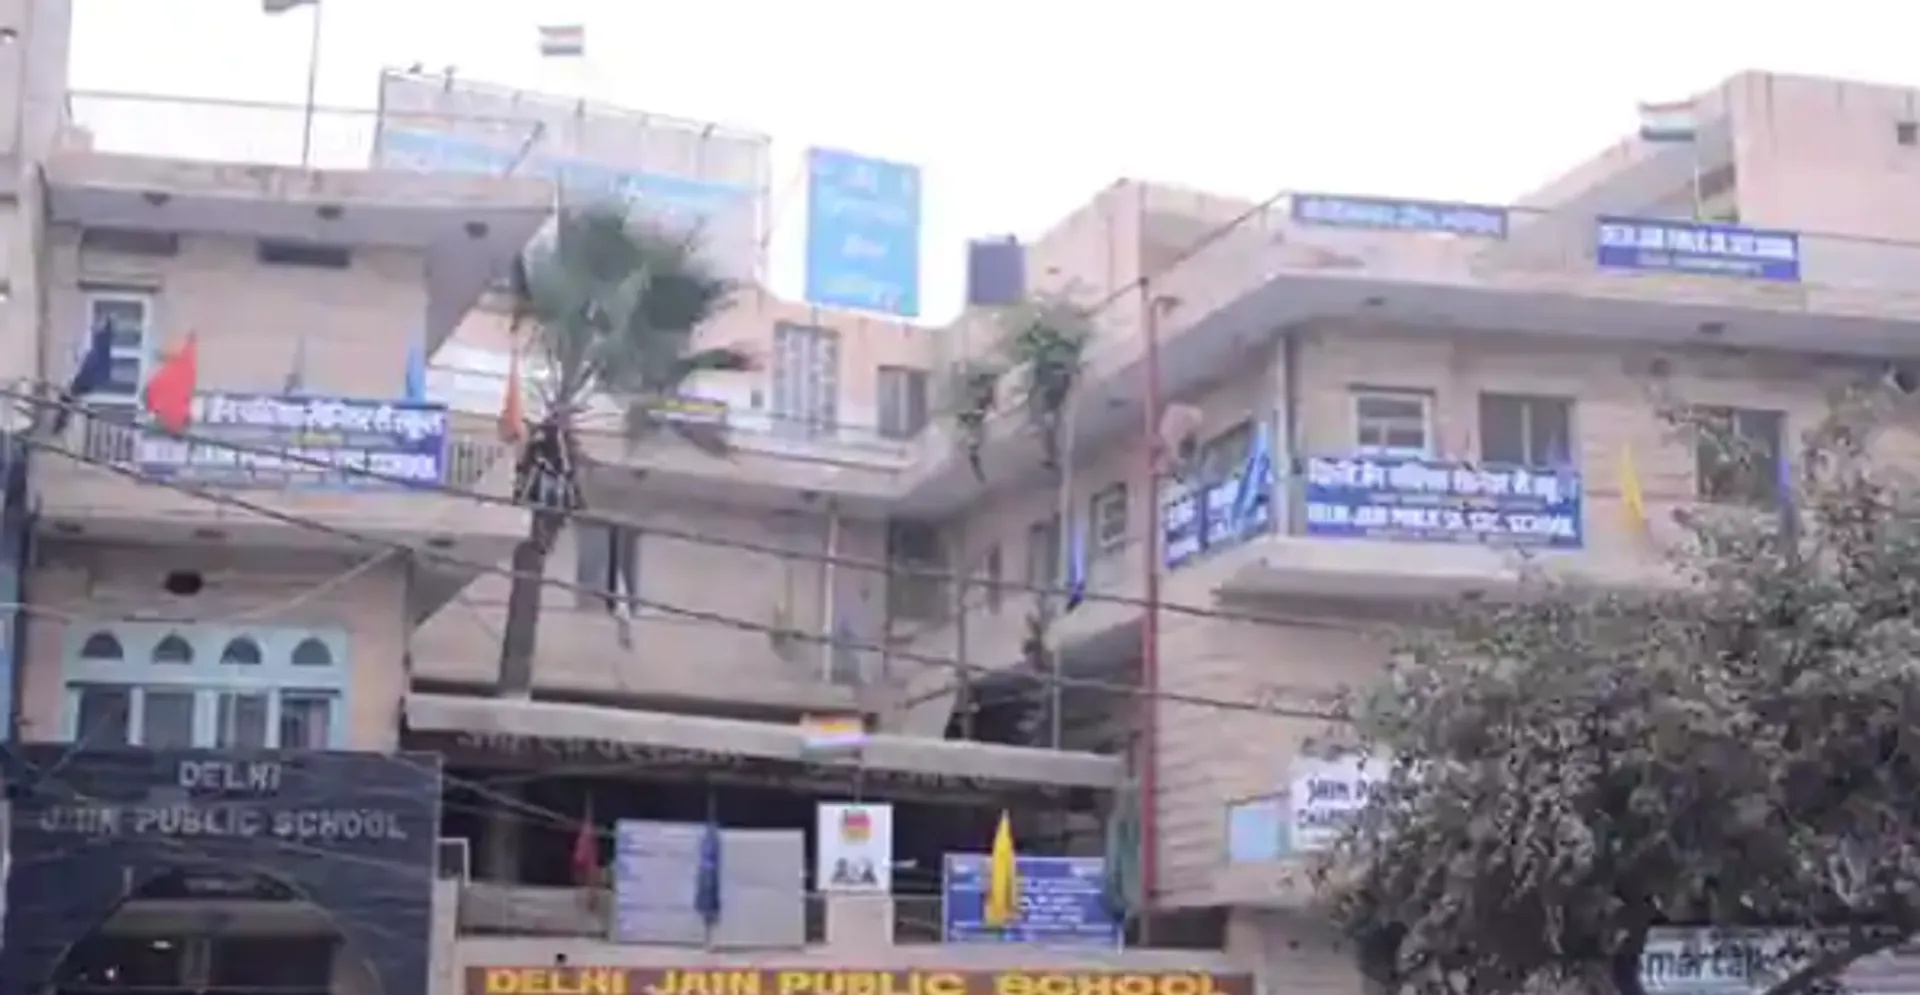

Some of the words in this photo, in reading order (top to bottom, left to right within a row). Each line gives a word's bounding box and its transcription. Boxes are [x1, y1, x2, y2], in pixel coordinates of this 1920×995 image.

[180, 760, 282, 790] DELHI
[134, 807, 263, 836] PUBLIC
[274, 808, 408, 840] SCHOOL
[485, 966, 624, 995] DELHI
[644, 967, 757, 995] JAIN
[775, 969, 967, 995] PUBLIC
[995, 972, 1229, 995] SCHOOL
